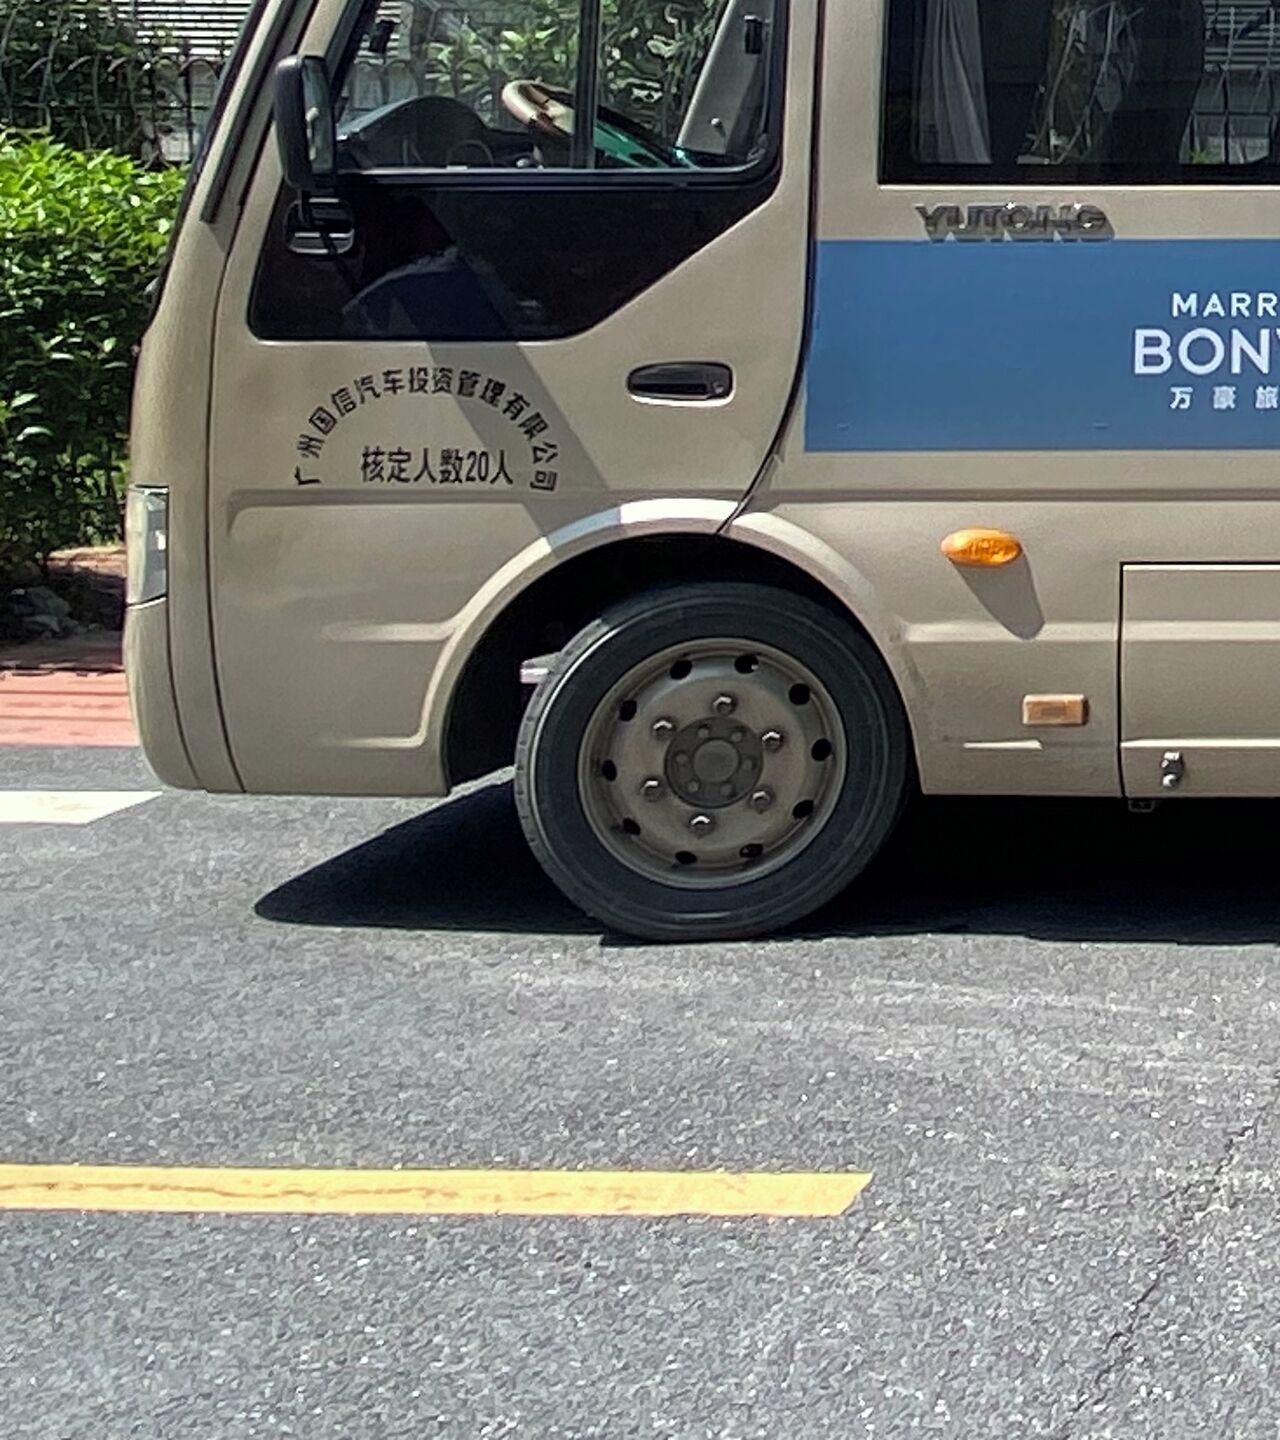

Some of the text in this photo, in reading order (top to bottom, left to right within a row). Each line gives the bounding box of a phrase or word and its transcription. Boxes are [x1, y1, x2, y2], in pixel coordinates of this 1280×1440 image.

[295, 366, 559, 493] 广州国信汽车投资管理有限公司
[360, 446, 514, 485] 核定人数20人
